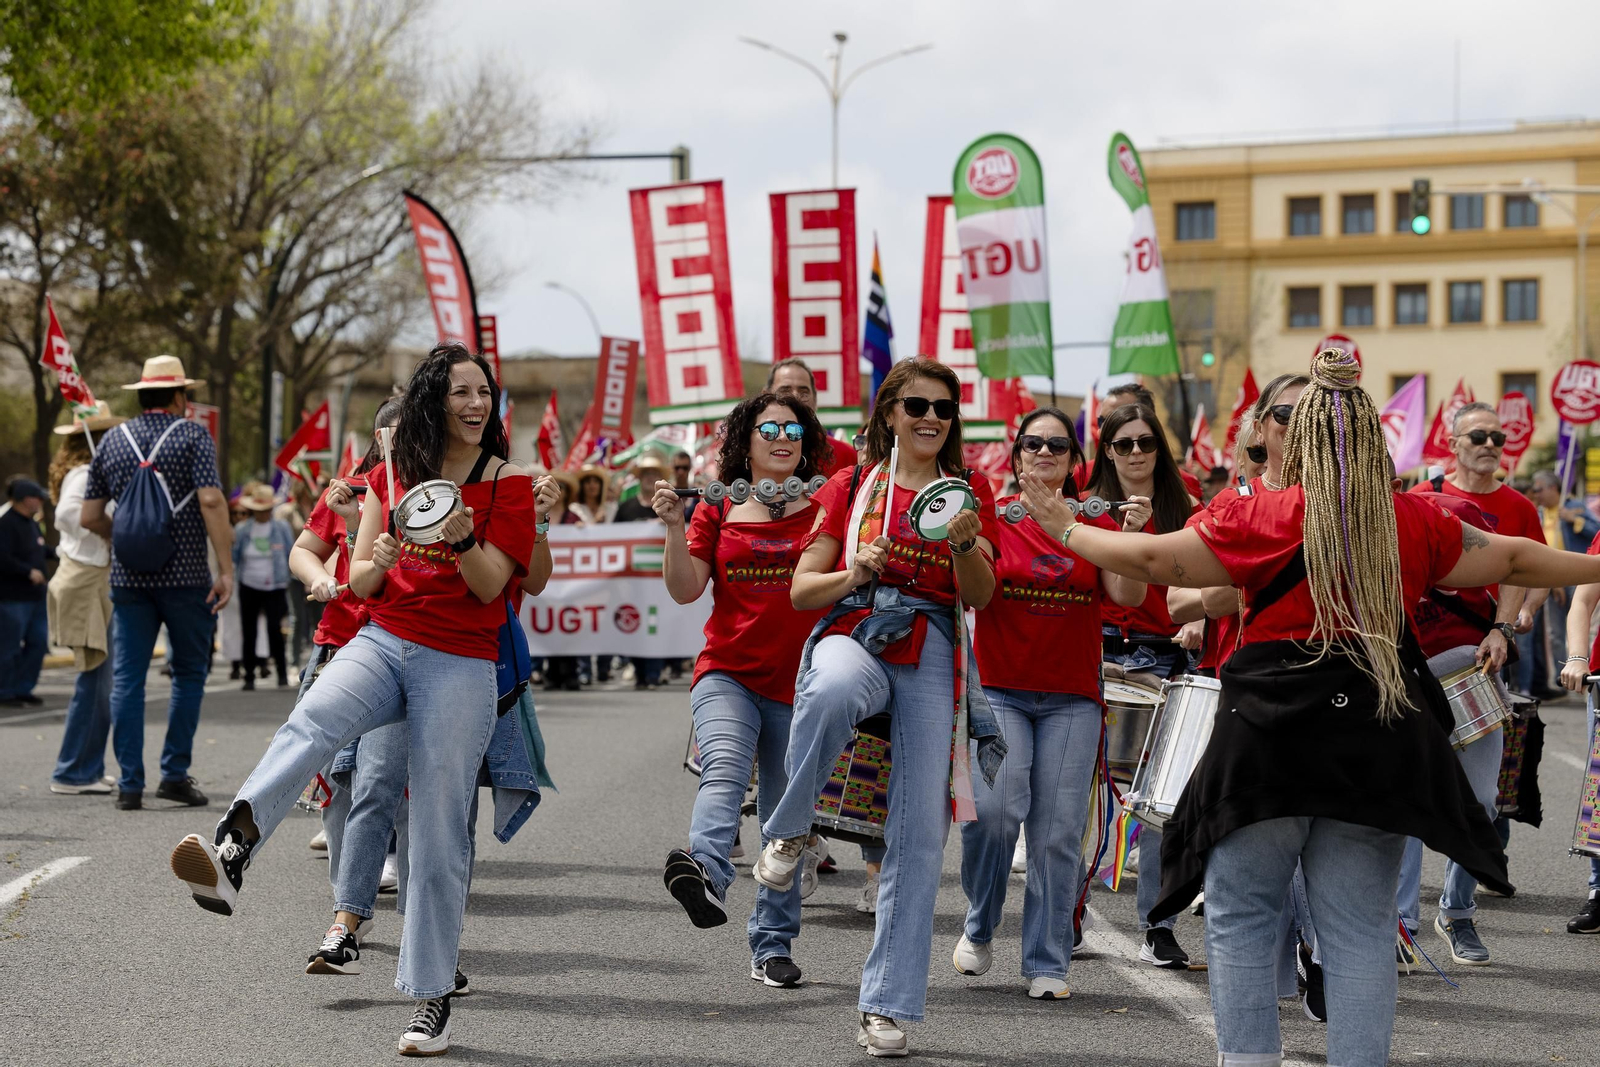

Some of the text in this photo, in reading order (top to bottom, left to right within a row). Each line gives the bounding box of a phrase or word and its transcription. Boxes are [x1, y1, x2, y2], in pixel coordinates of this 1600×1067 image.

[648, 184, 726, 405] CCOO
[603, 339, 630, 417] CCOO
[530, 605, 605, 634] UGT
